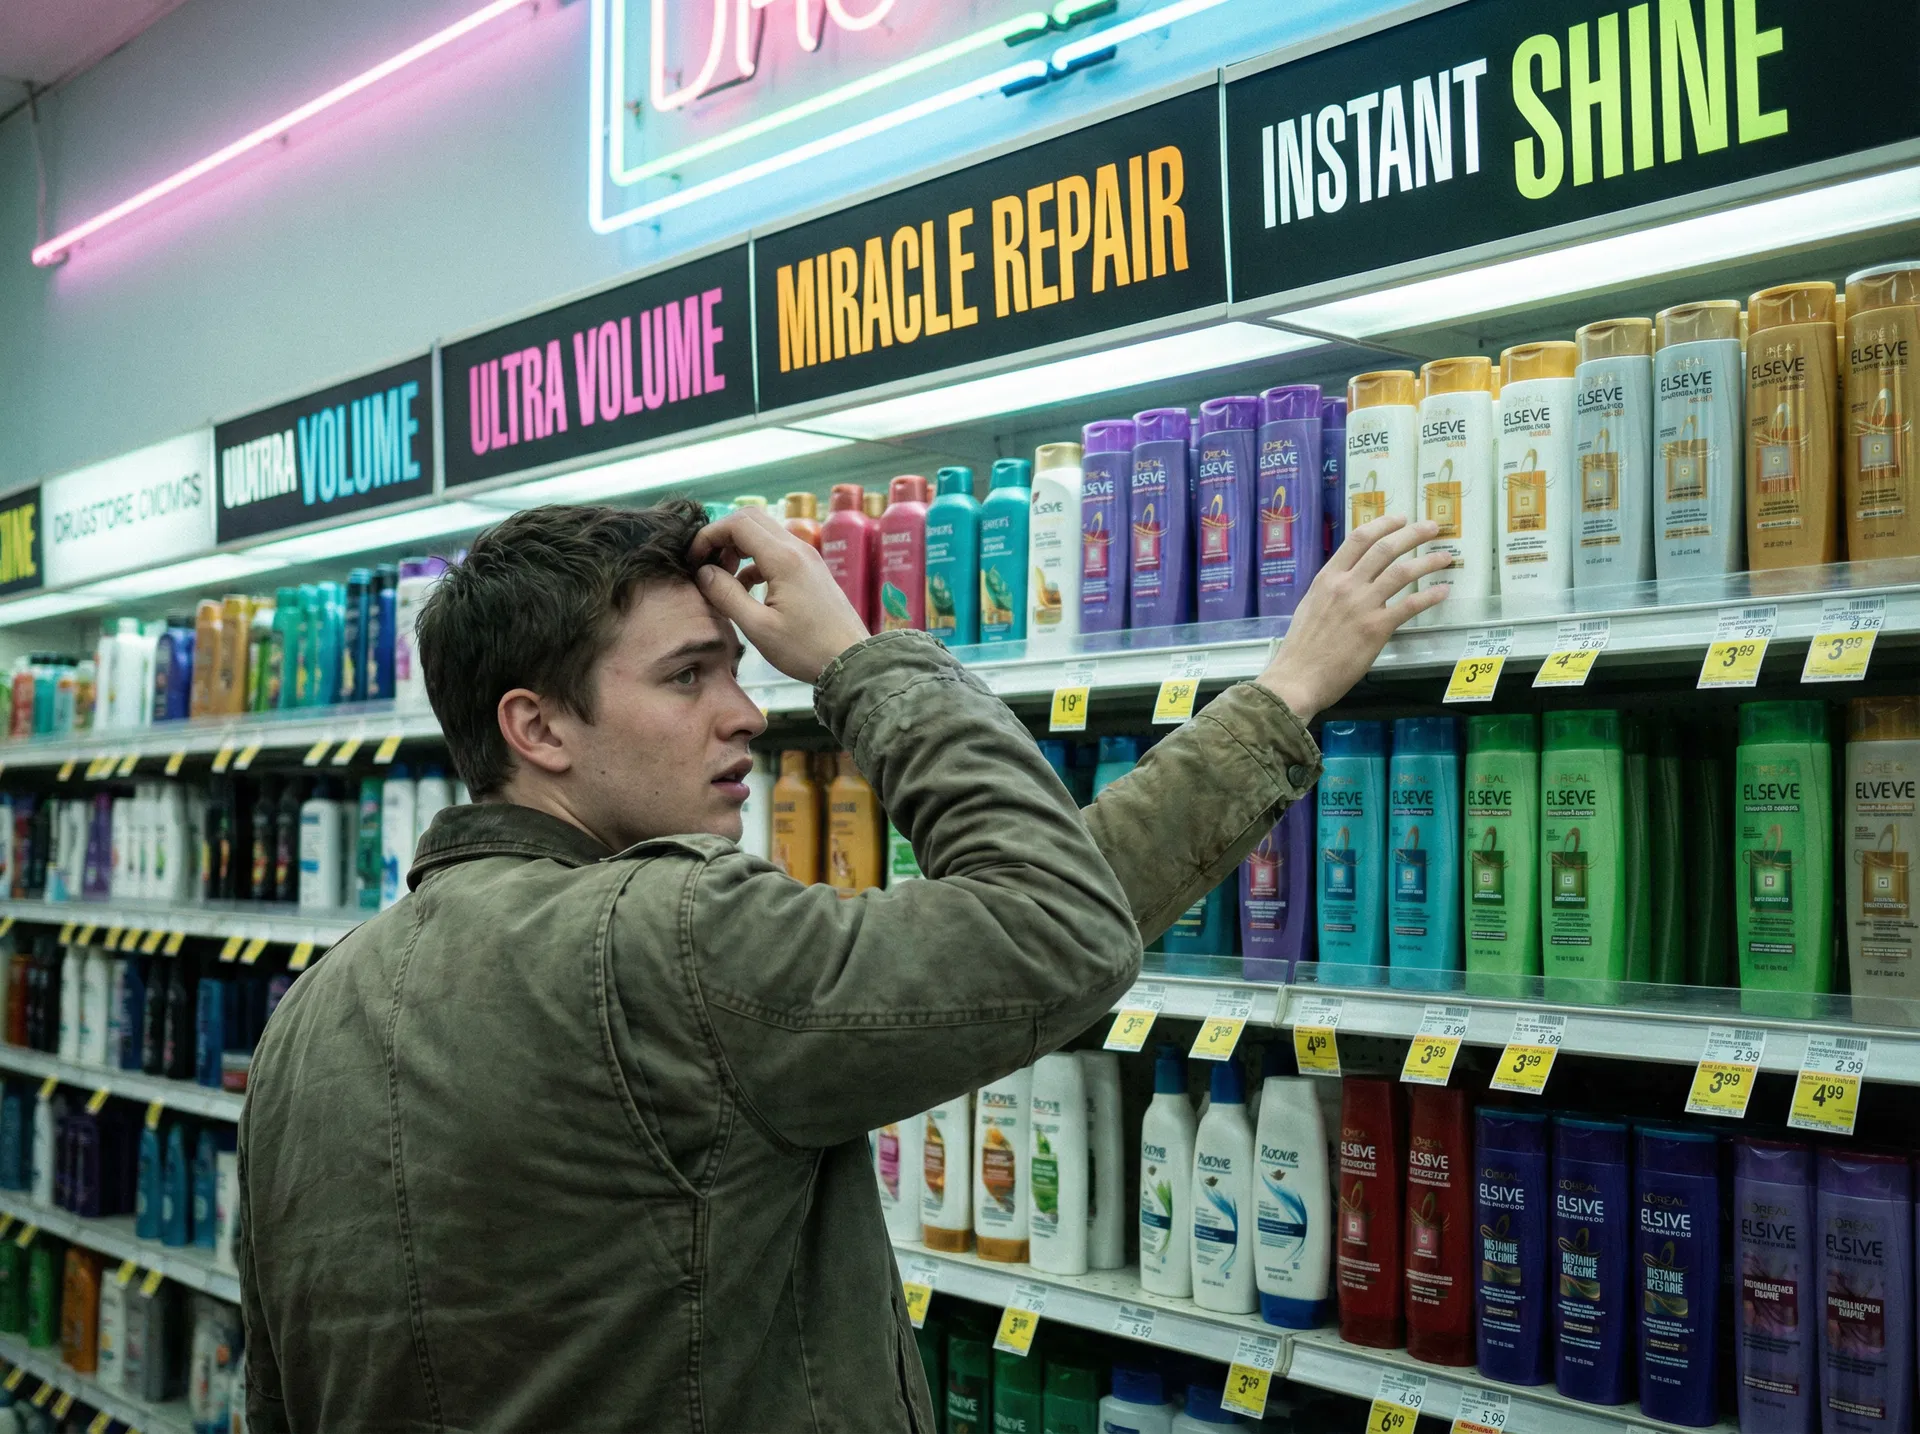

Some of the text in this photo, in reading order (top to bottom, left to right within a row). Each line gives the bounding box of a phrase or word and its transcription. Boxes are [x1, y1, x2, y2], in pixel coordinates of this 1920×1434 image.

[1261, 0, 1789, 229] INSTANT SHINE
[776, 145, 1189, 372] MIRACLE REPAIR
[1851, 340, 1908, 365] ELSEVE
[469, 287, 726, 455] ULTRA VOLUME
[1751, 357, 1805, 380] ELSEVE
[1661, 371, 1712, 392] ELSEVE
[1578, 386, 1623, 407] ELSEVE
[1504, 407, 1550, 427] ELSEVE
[1423, 419, 1466, 439] ELSEVE
[298, 381, 420, 505] VOLUME
[1349, 431, 1388, 450] ELSEVE
[1260, 451, 1298, 469] ELSEVE
[1321, 790, 1363, 807] ELSEVE
[1392, 789, 1434, 806] ELSEVE
[1468, 790, 1512, 806] ELSEVE
[1546, 789, 1596, 806] ELSEVE
[1743, 783, 1800, 801] ELSEVE
[1855, 781, 1915, 799] ELVEVE
[1307, 1036, 1326, 1056] 499
[1733, 1049, 1760, 1063] 2.99
[1513, 1054, 1541, 1074] 399
[1835, 1059, 1863, 1074] 2.99
[1710, 1072, 1740, 1094] 399
[1813, 1084, 1844, 1107] 499
[1479, 1182, 1525, 1204] ELSIVE
[1557, 1195, 1604, 1217] ELSIVE
[1641, 1207, 1692, 1231] ELSIVE
[1741, 1218, 1797, 1242] ELSIVE
[1825, 1233, 1884, 1259] ELSIVE
[1399, 1392, 1422, 1408] 4.99
[1381, 1411, 1405, 1432] 699
[1481, 1410, 1505, 1427] 5.99
